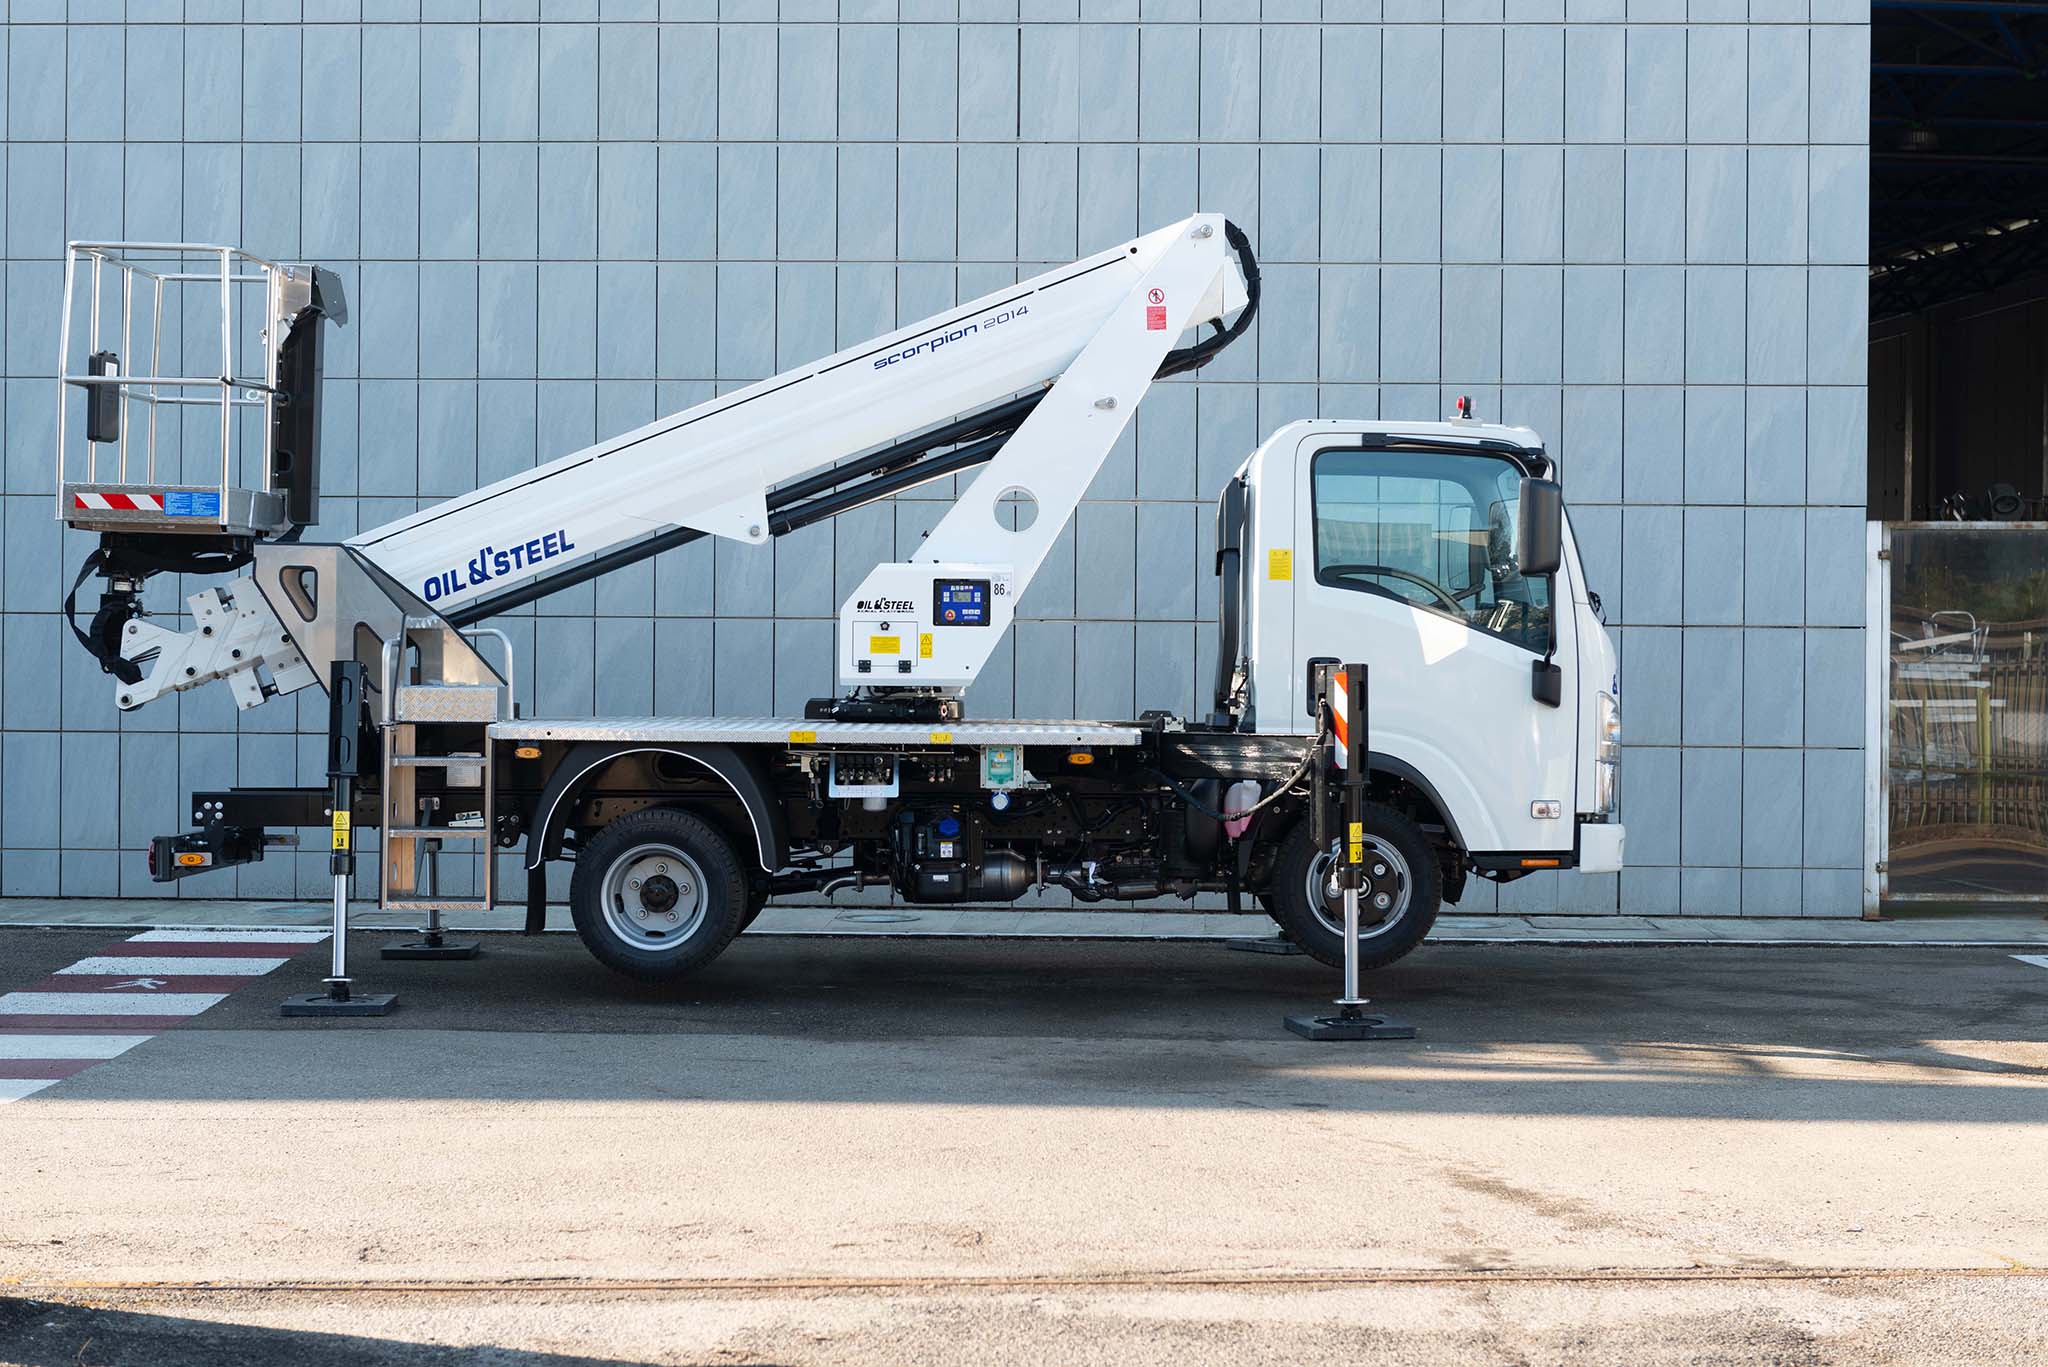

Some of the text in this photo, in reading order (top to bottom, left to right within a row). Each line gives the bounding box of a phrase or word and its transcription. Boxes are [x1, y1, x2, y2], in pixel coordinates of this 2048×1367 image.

[874, 305, 1029, 370] scorpion 2014
[993, 583, 1005, 596] 86
